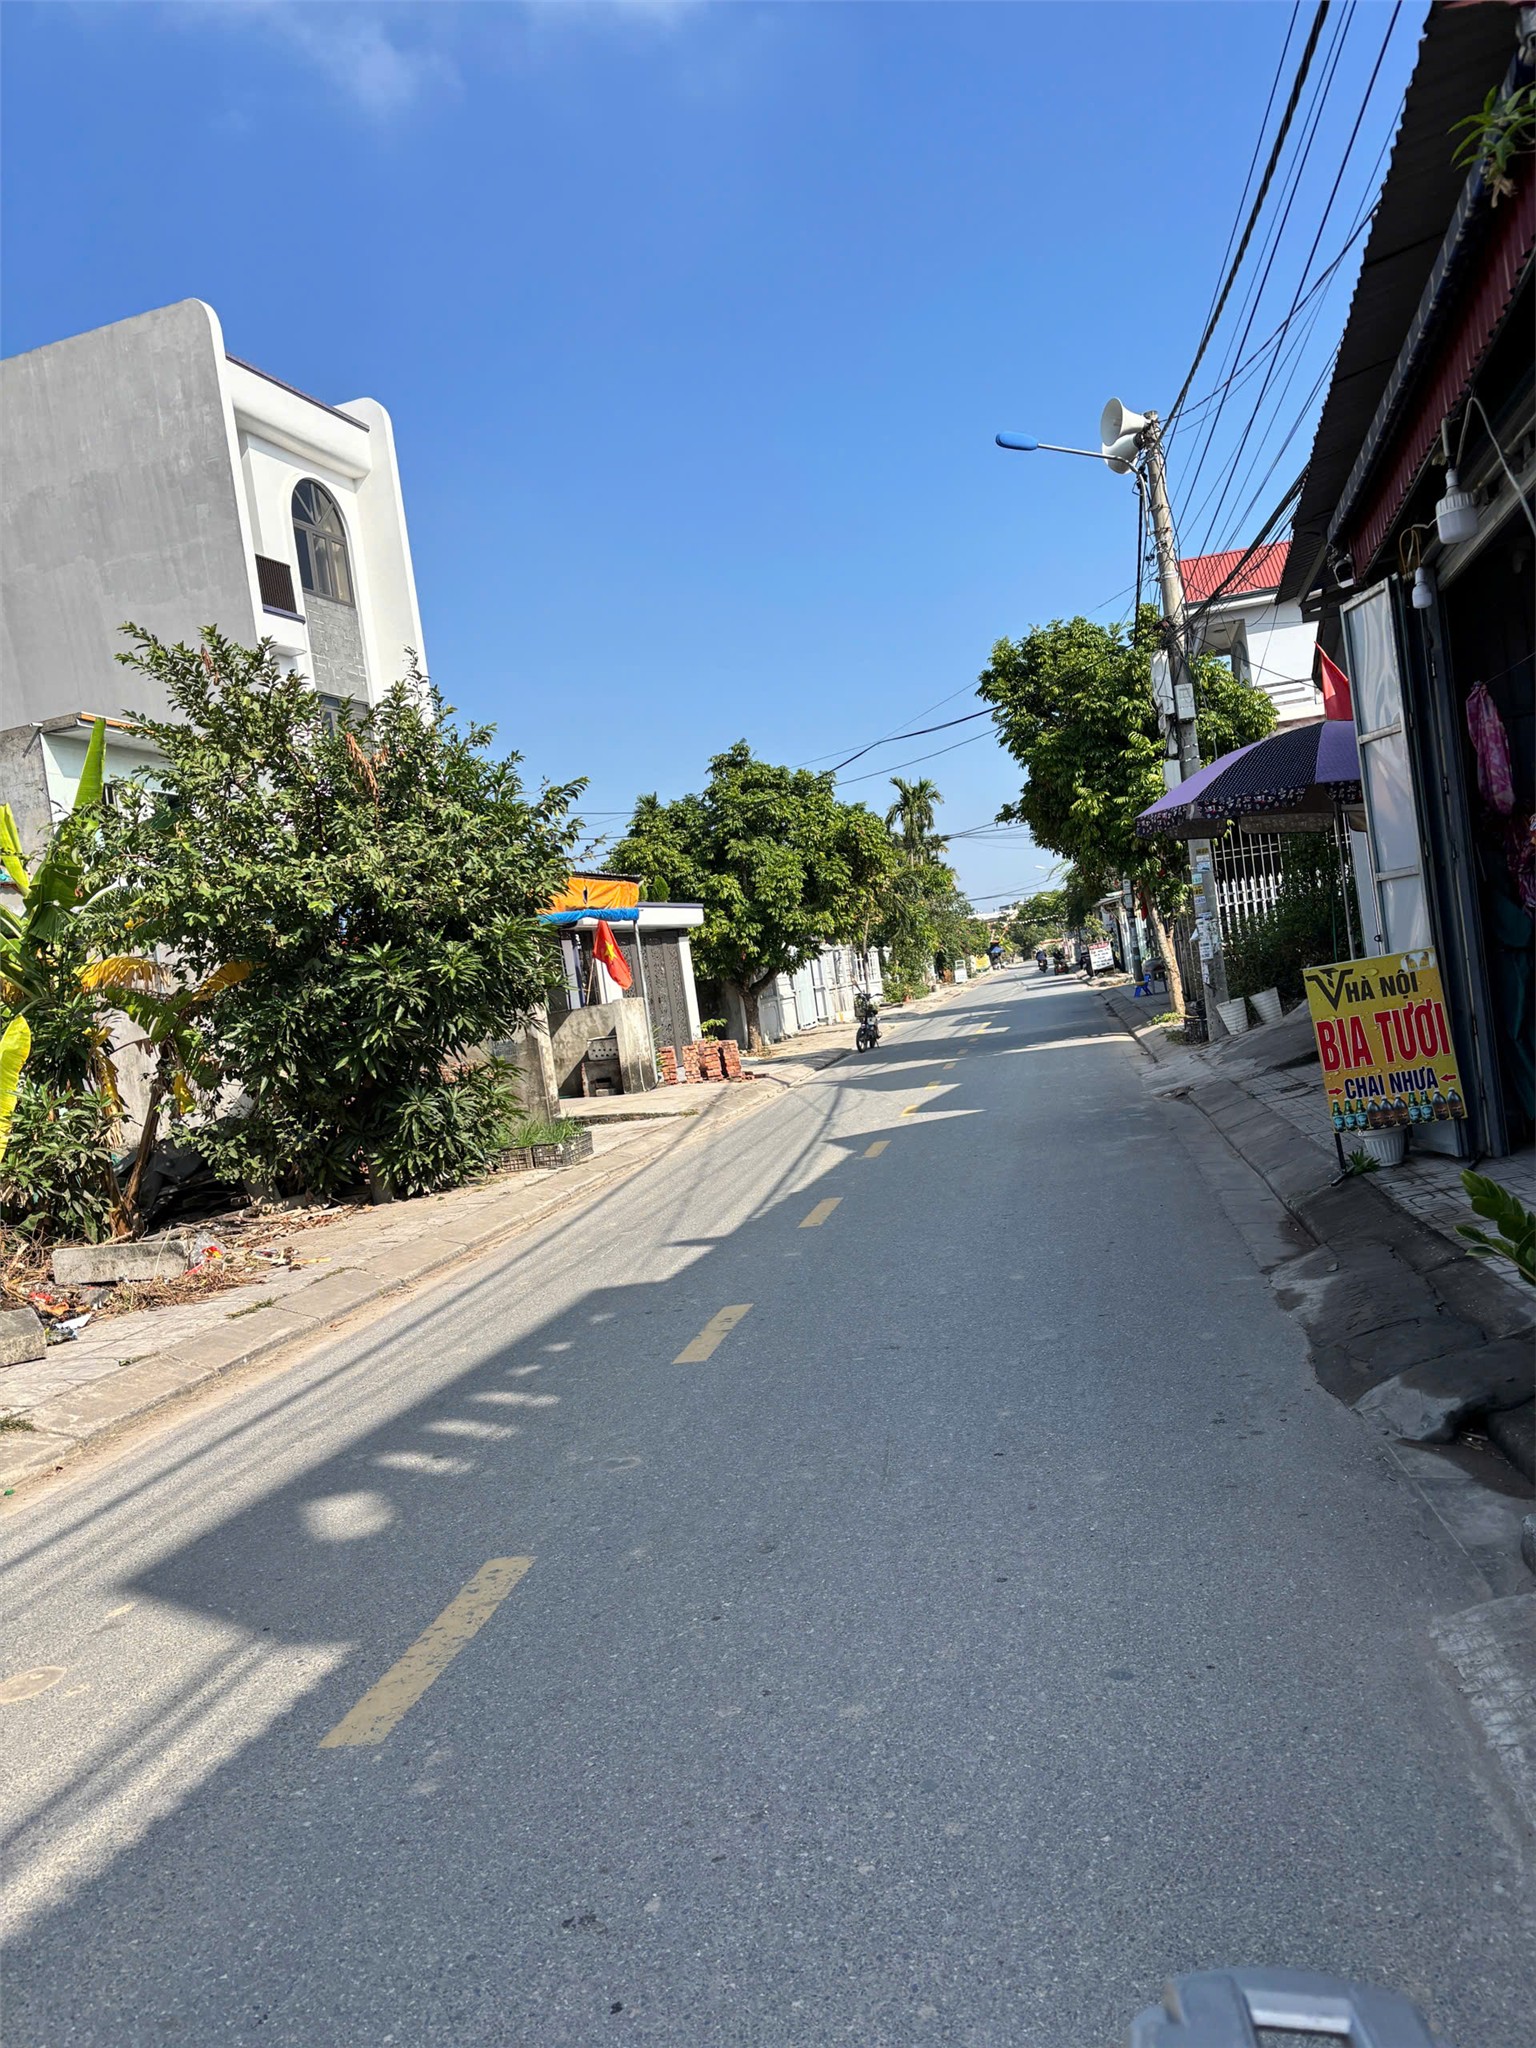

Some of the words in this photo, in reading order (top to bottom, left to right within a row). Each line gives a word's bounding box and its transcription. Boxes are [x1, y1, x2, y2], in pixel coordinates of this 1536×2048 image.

[1379, 969, 1419, 999] NỘI
[1316, 1015, 1374, 1072] BIA
[1374, 998, 1451, 1064] TƯƠI
[1344, 1074, 1385, 1099] CHAI
